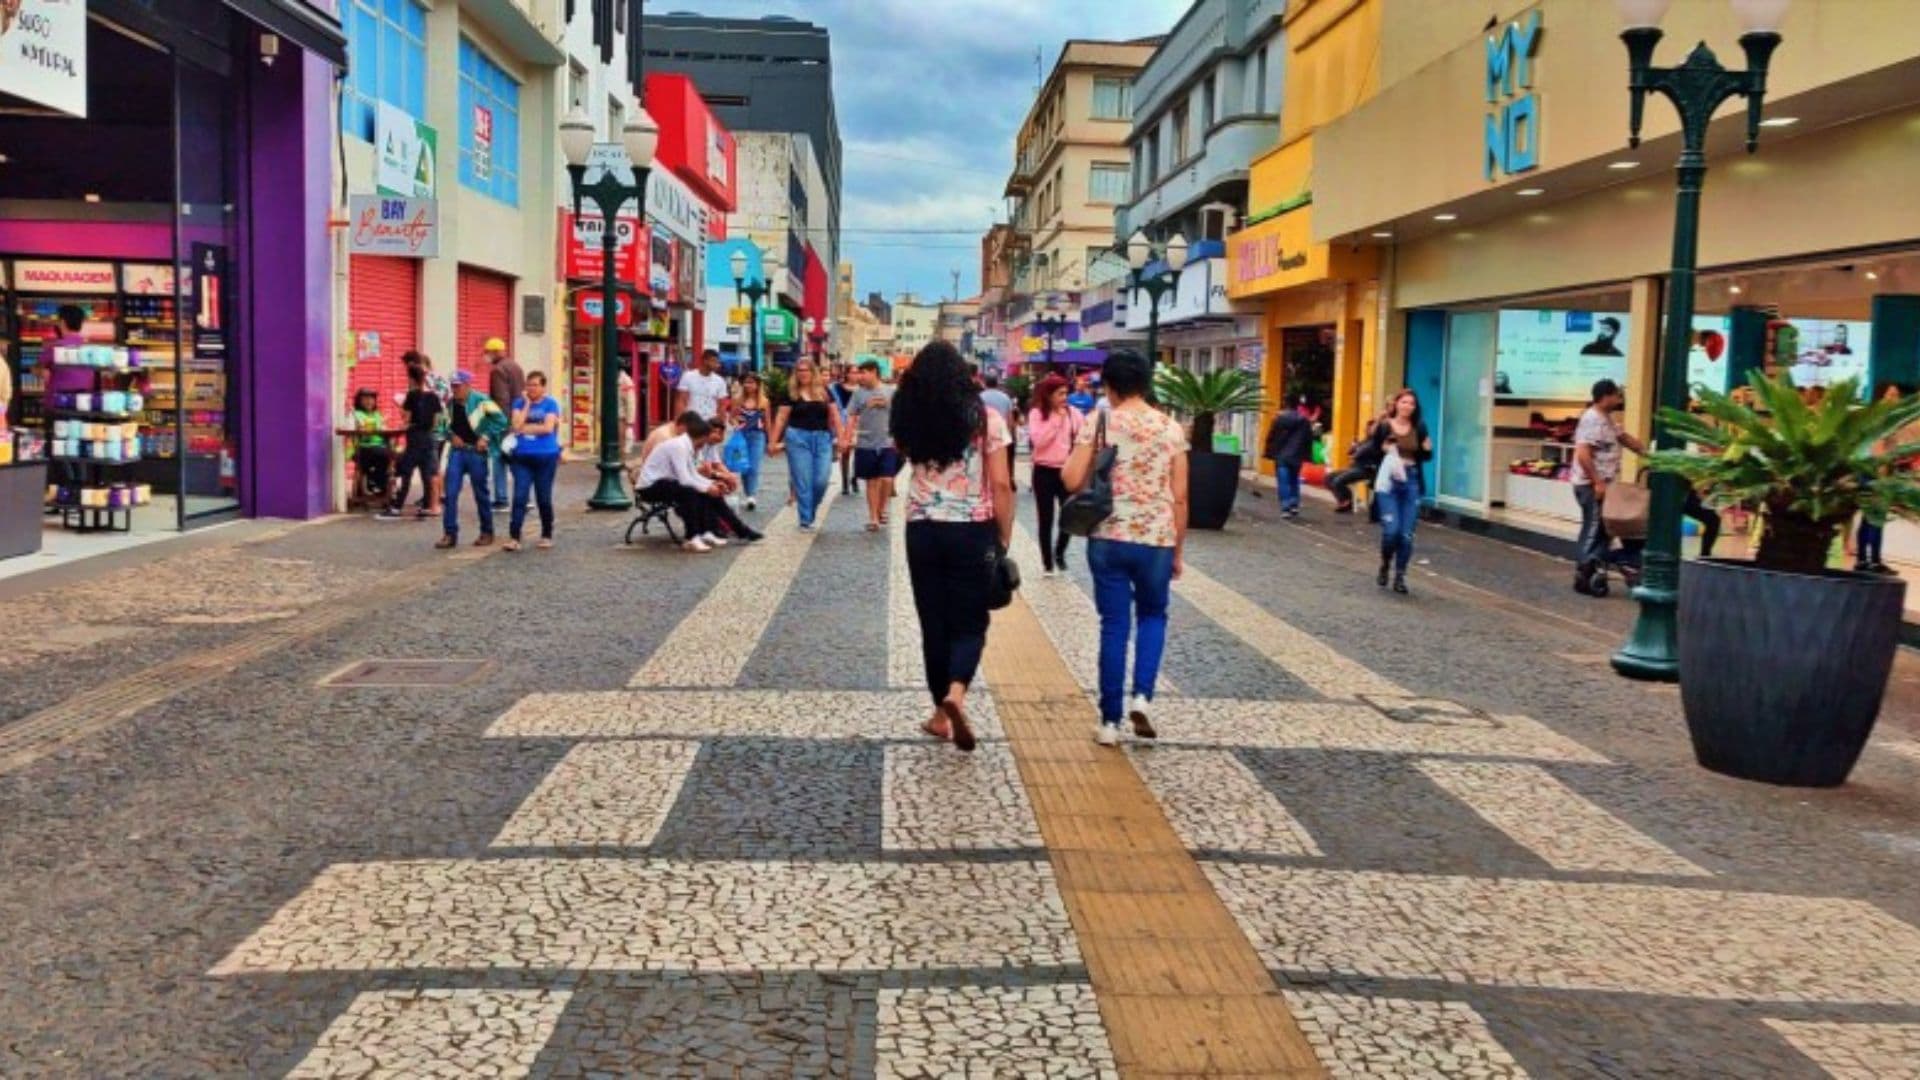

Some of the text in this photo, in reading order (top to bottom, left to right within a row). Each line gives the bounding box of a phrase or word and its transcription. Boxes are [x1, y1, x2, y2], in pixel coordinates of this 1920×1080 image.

[1486, 8, 1544, 104] MY
[1484, 92, 1542, 182] NO
[381, 200, 407, 220] BAY
[354, 206, 433, 251] Beauty
[575, 220, 630, 237] TRIO
[24, 269, 112, 285] MAQUIAGEM
